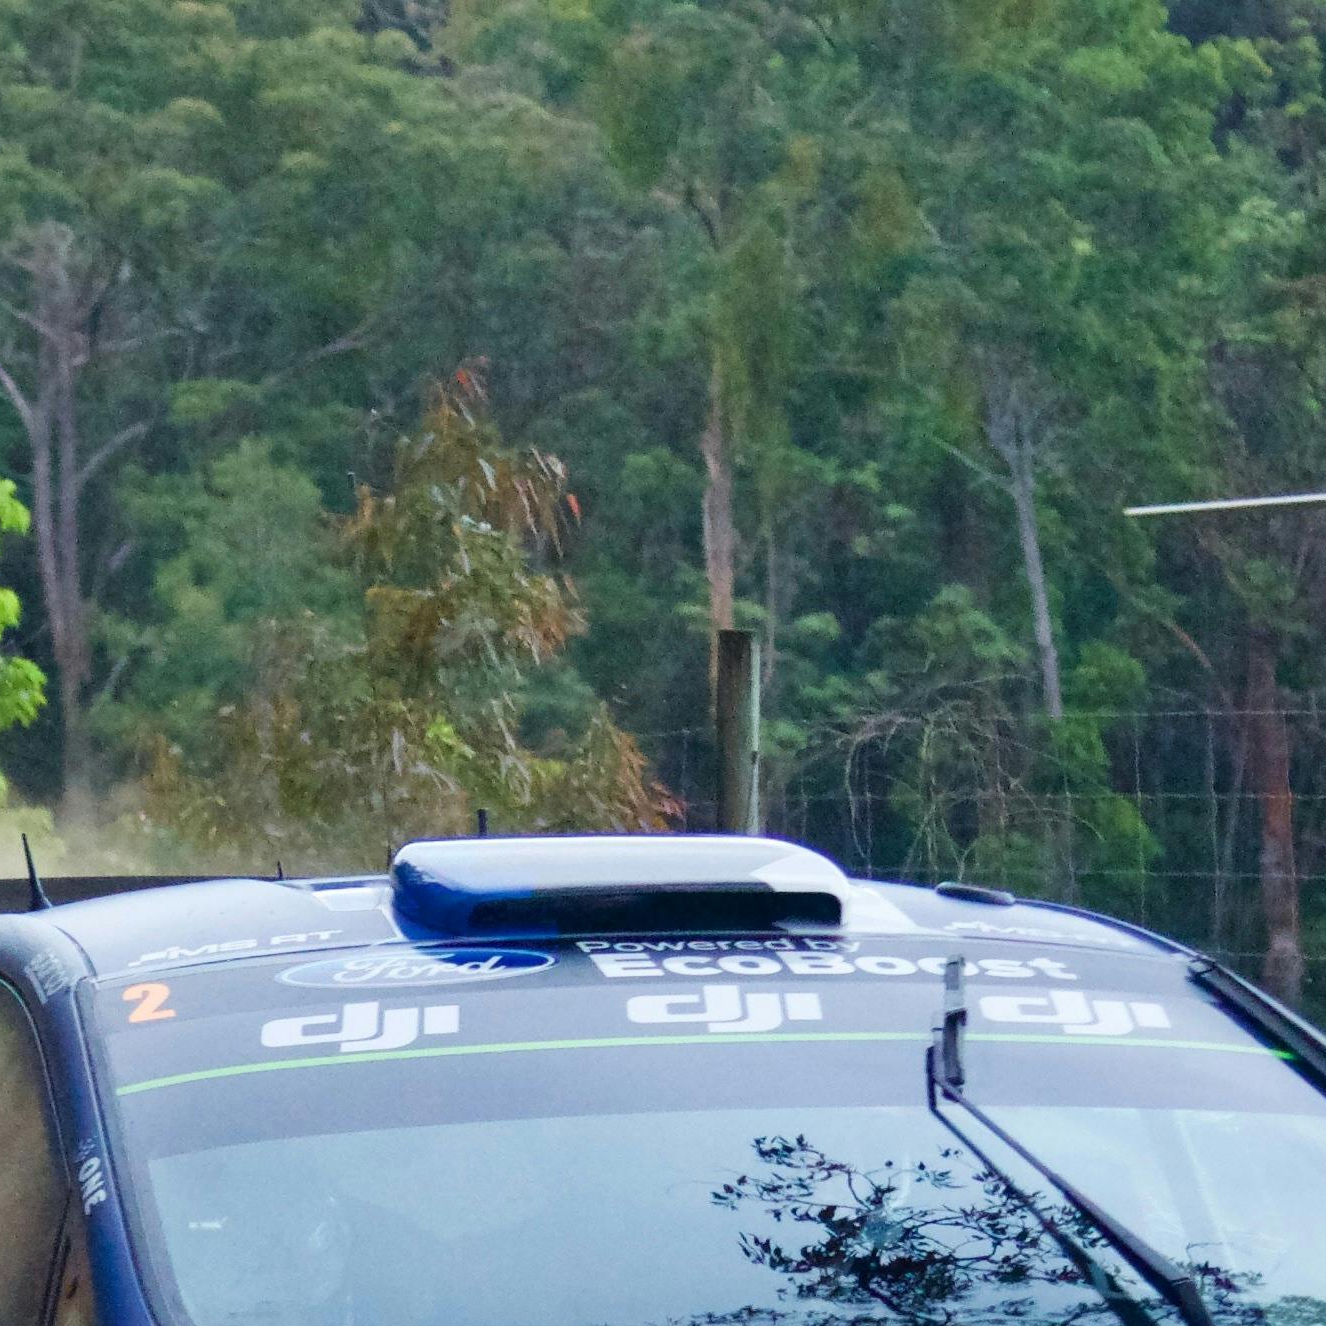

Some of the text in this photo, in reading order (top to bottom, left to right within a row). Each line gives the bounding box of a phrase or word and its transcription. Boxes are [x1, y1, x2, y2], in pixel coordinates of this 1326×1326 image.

[575, 937, 862, 953] Powered by
[332, 950, 506, 984] Ford
[590, 952, 1078, 981] EcoBoost
[122, 983, 176, 1024] 2
